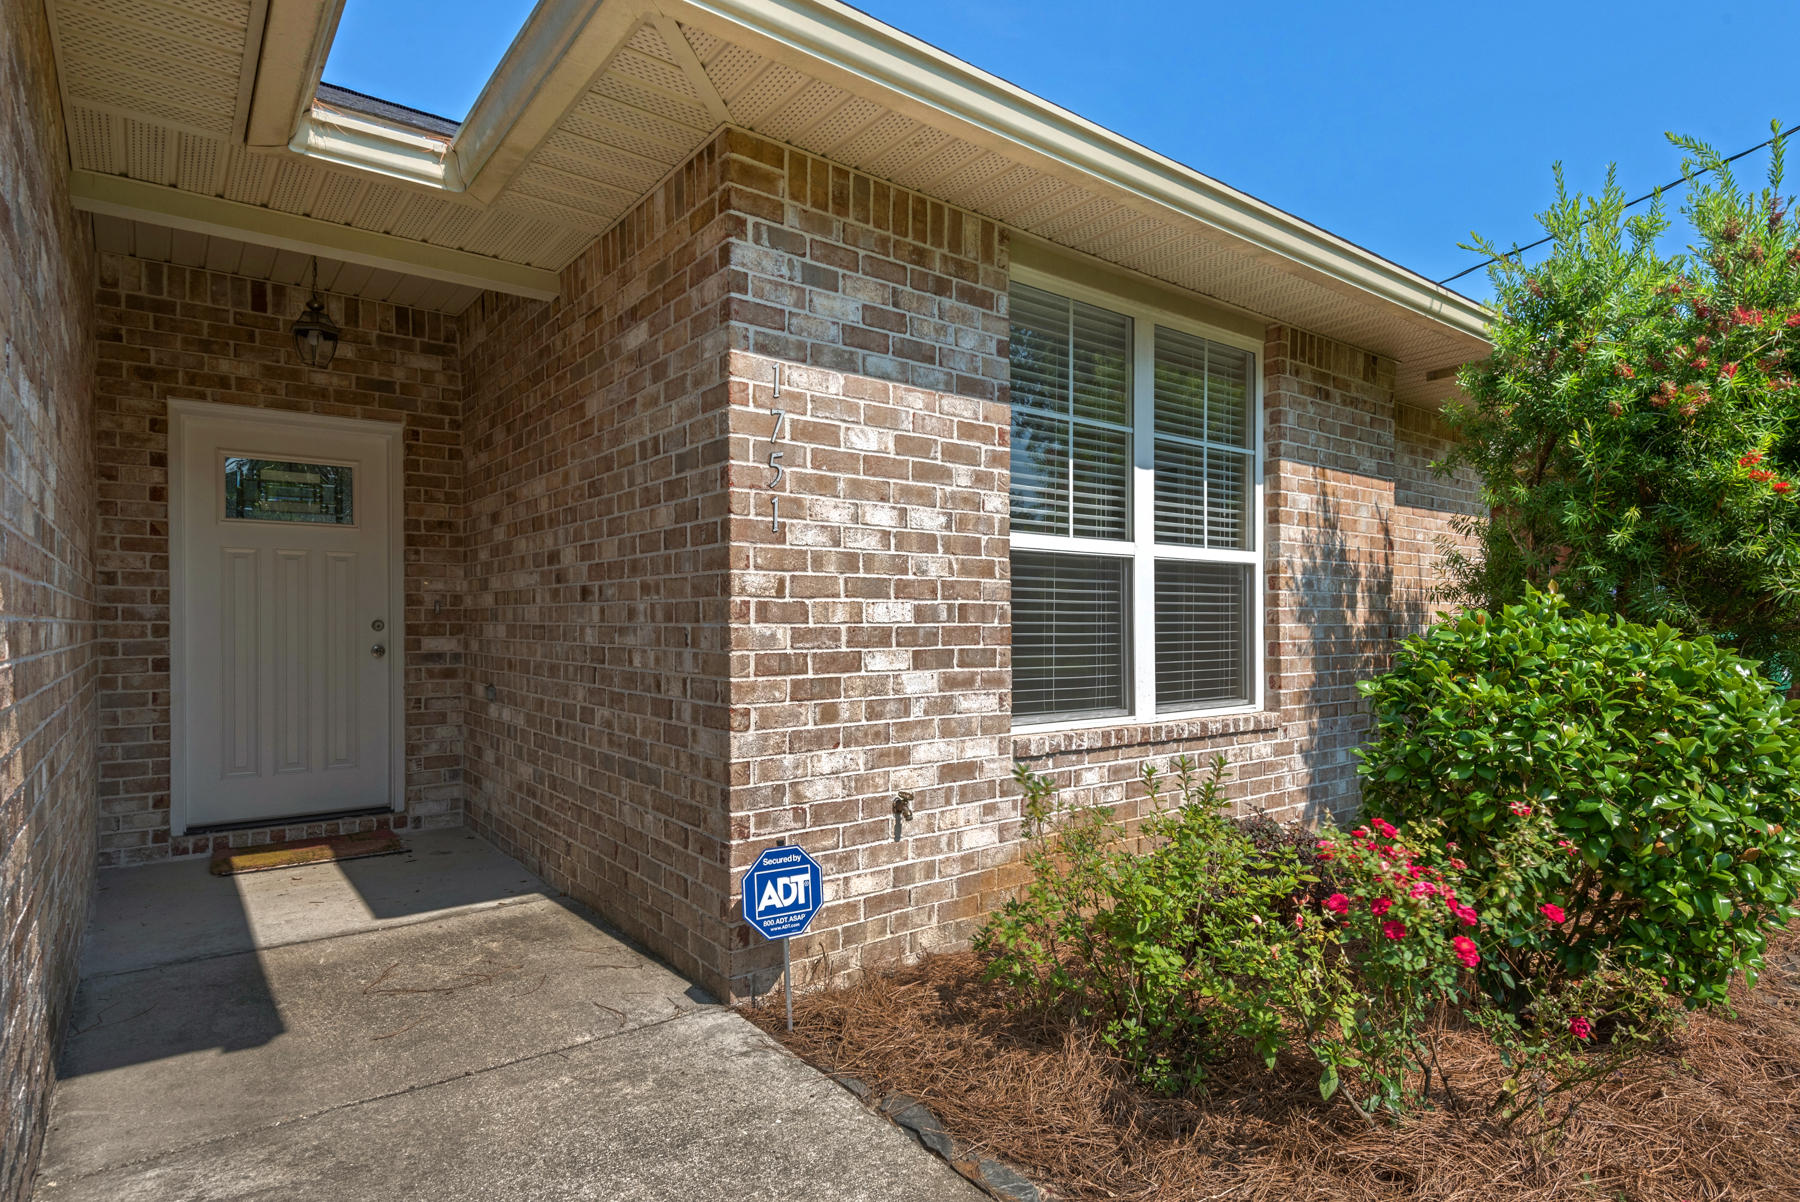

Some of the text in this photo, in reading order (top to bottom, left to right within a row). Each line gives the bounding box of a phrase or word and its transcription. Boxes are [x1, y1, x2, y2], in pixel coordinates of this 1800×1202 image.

[769, 362, 786, 533] 1751
[762, 854, 802, 866] Secured by
[758, 873, 810, 911] ADT
[770, 923, 800, 931] www.ADT.com
